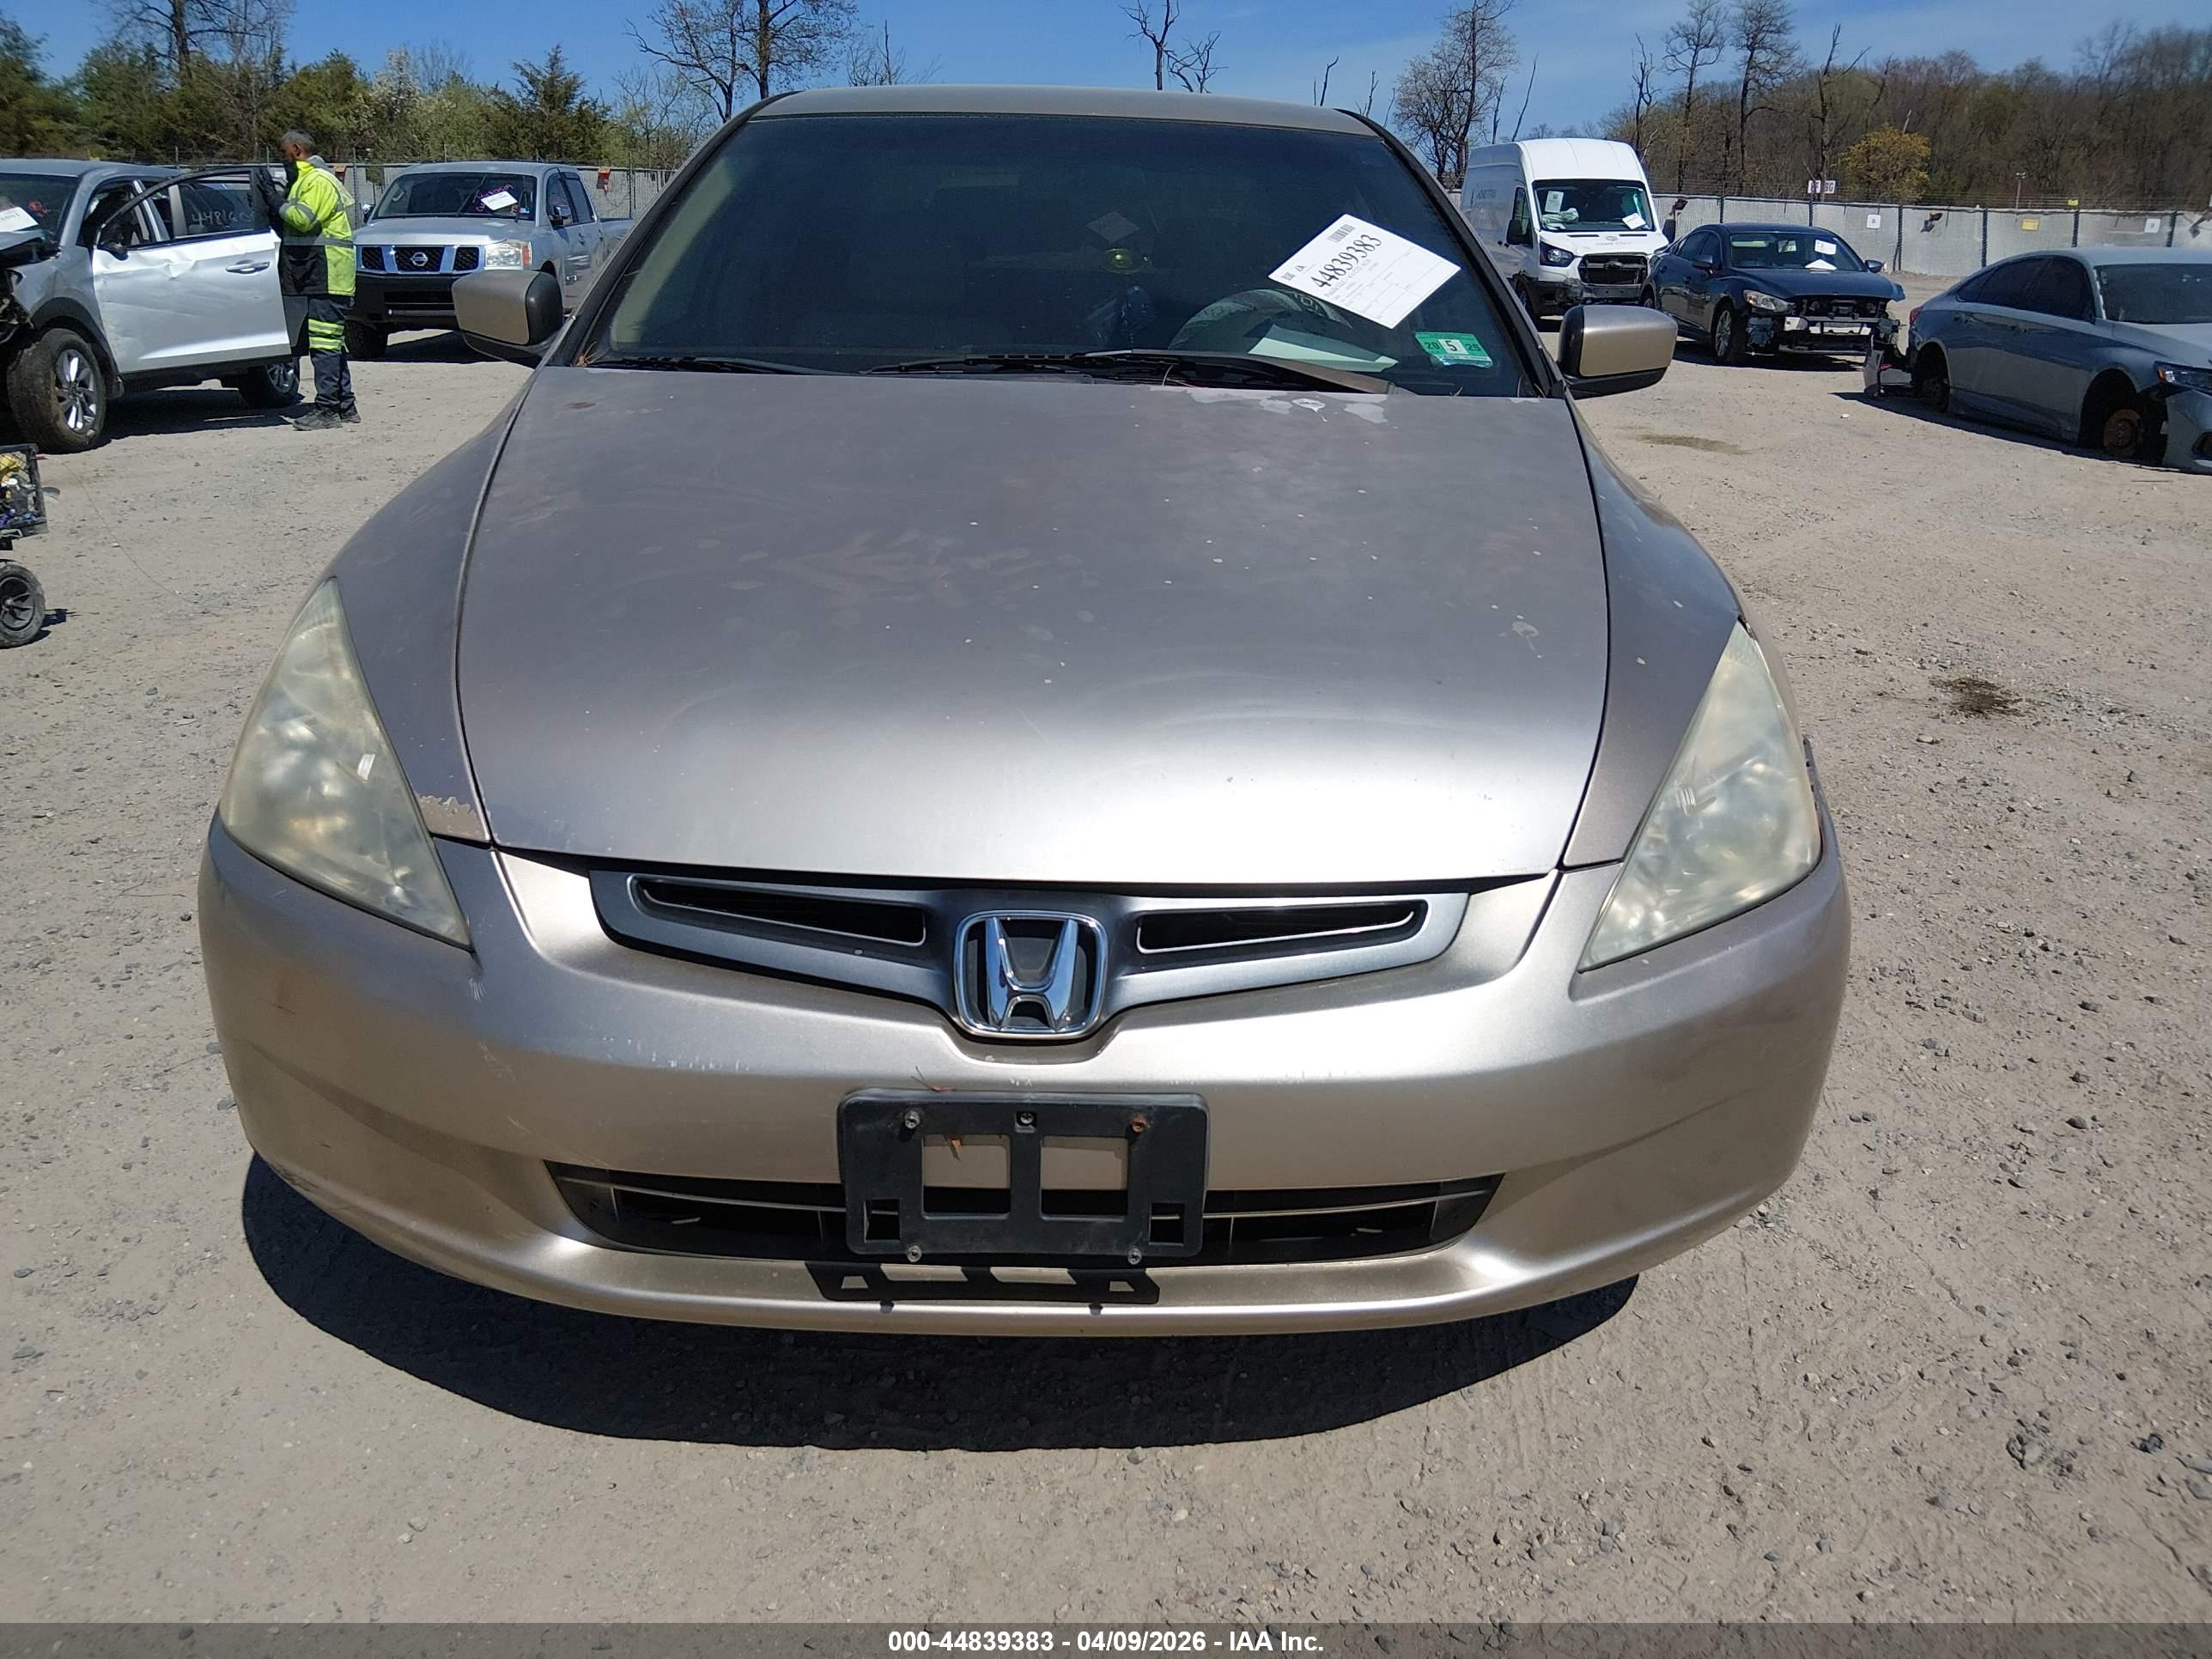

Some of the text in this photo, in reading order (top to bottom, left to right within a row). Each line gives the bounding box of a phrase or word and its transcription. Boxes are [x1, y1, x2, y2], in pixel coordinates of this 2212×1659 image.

[1310, 234, 1382, 288] 44839383
[1425, 340, 1481, 352] 20 5 25
